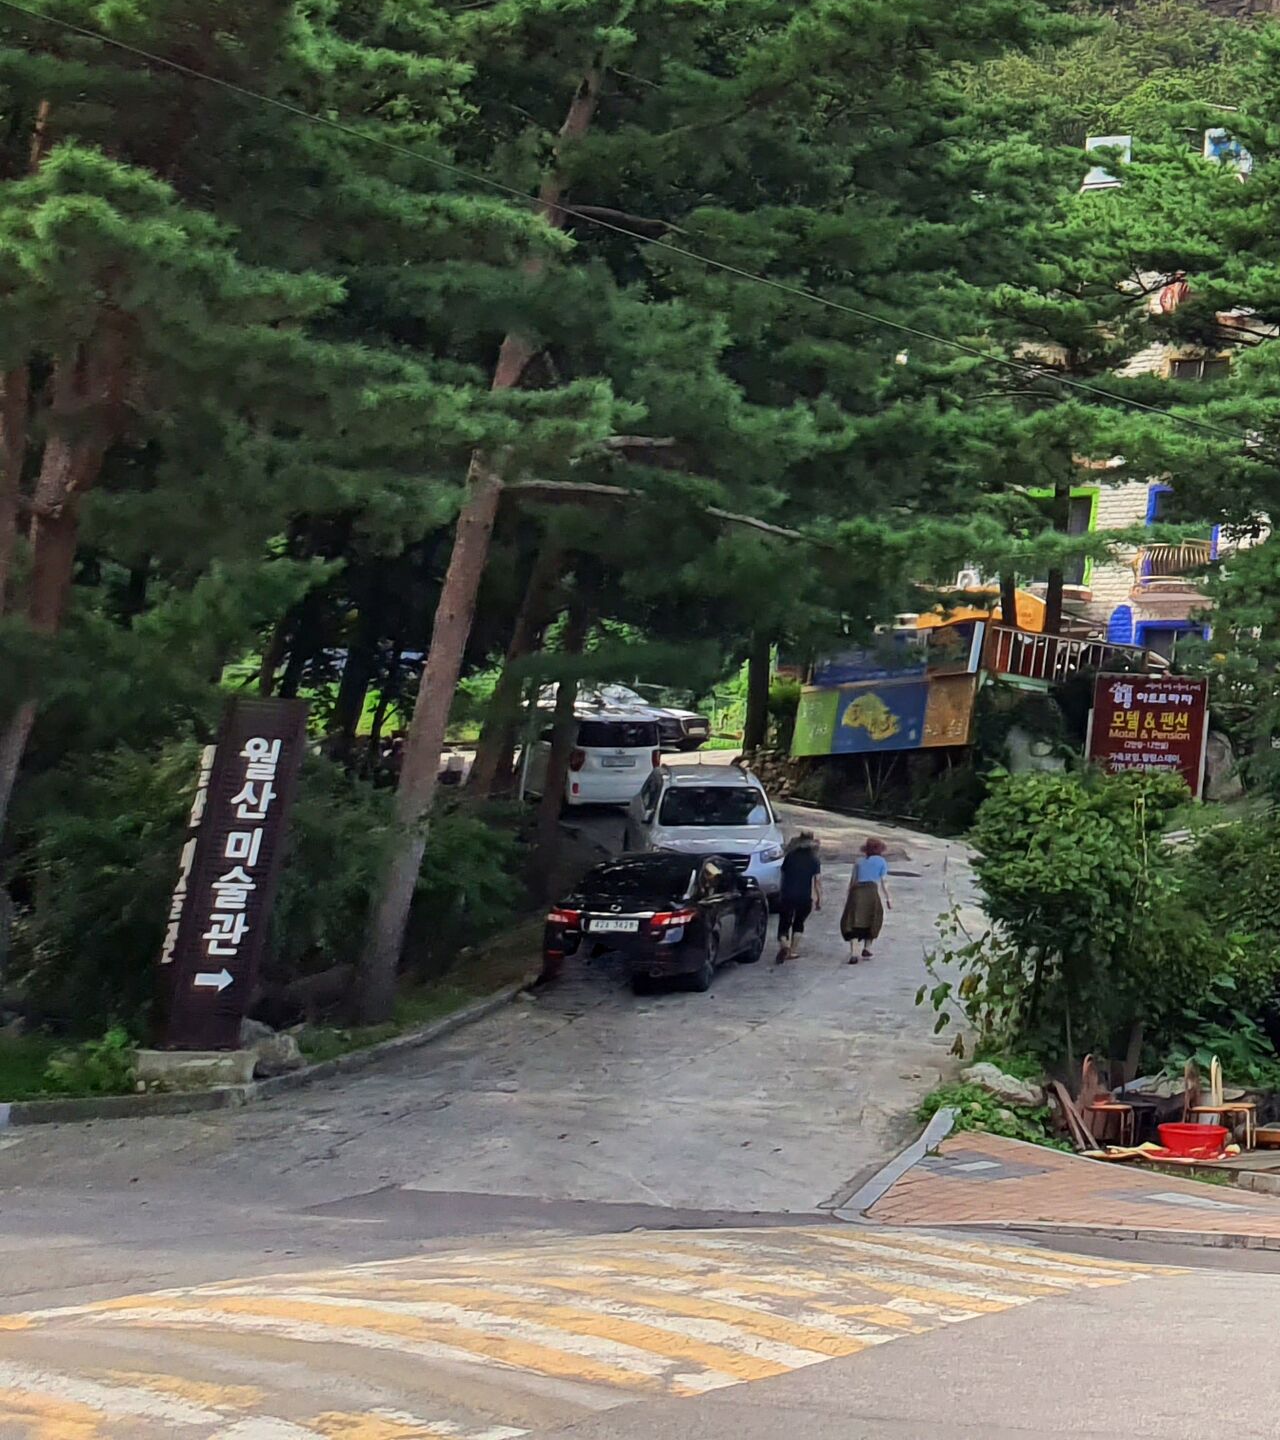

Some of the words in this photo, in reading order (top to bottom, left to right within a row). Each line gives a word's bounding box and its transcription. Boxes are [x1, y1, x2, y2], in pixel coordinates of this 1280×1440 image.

[1110, 711, 1140, 730] 모텔
[1144, 711, 1155, 728] &
[1160, 712, 1189, 731] 펜션
[1109, 729, 1137, 738] Motel
[1151, 730, 1190, 740] Pension
